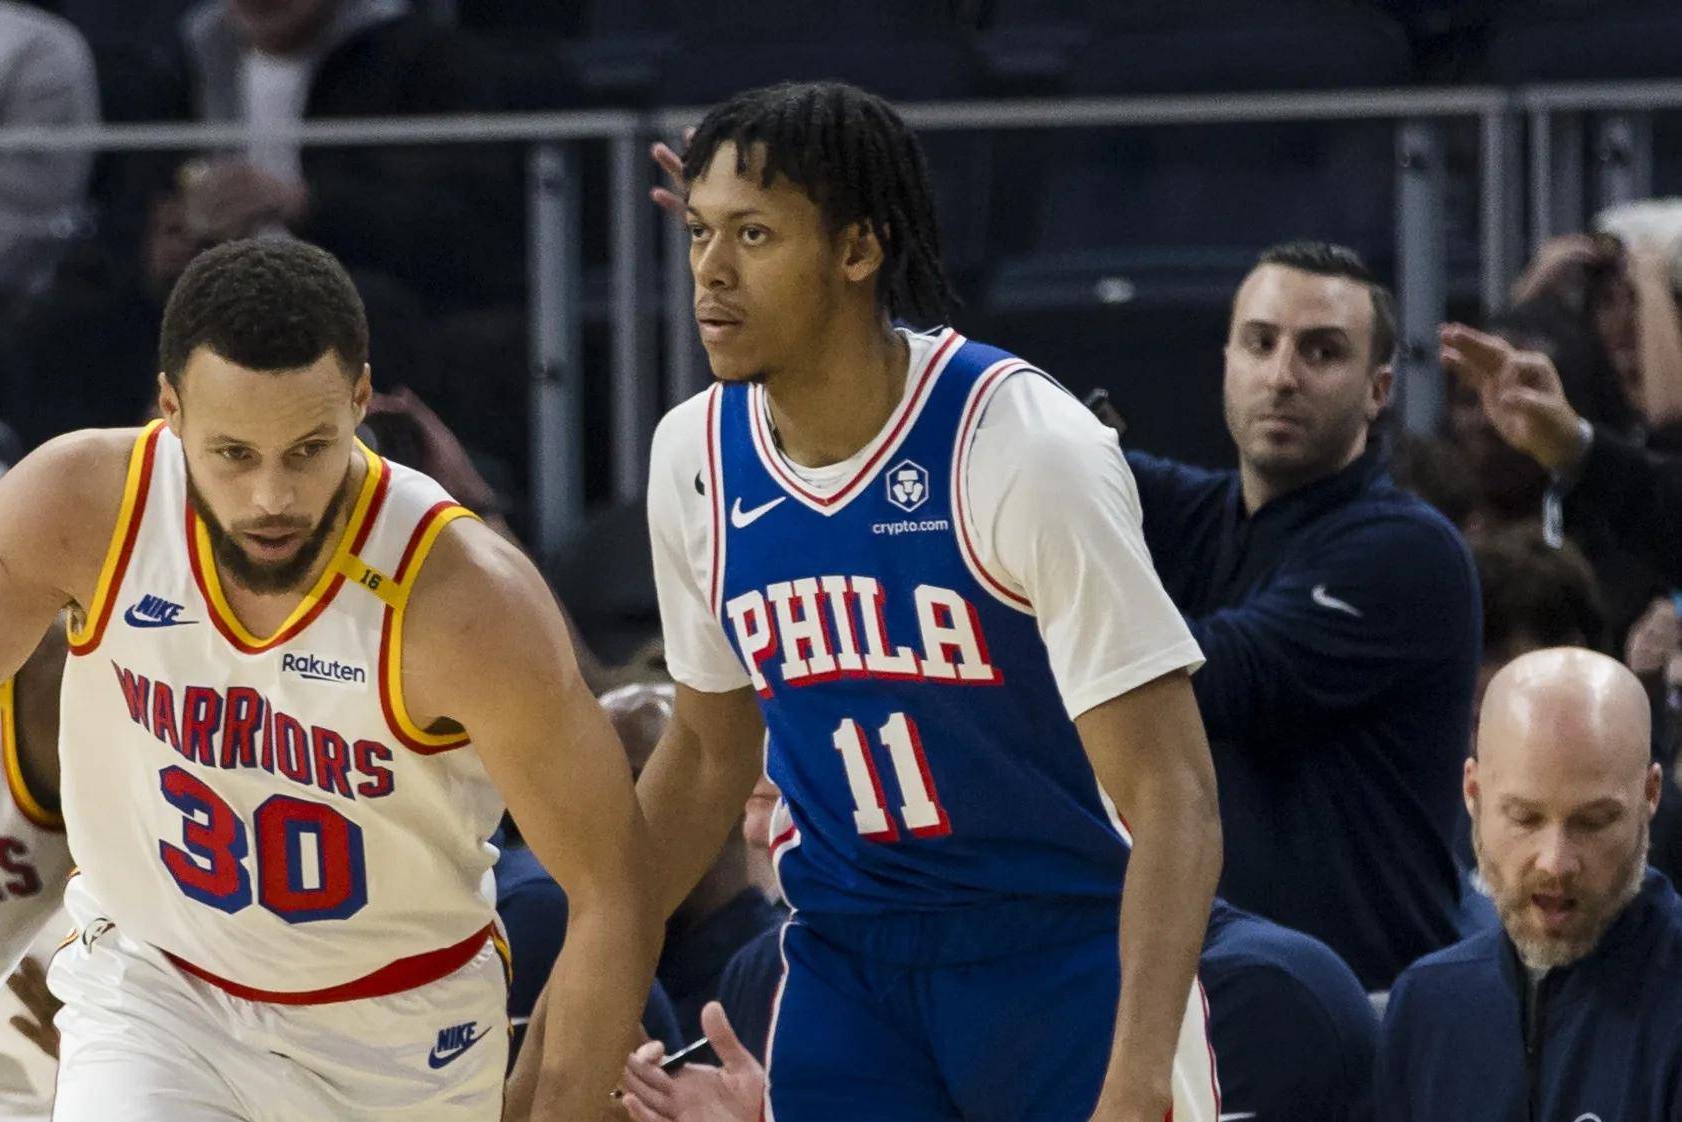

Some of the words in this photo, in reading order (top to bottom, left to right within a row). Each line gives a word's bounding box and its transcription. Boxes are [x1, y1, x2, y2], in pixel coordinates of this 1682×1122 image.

[872, 519, 950, 536] crypto.com
[360, 568, 382, 590] 16
[135, 594, 185, 623] NIKE
[726, 575, 1004, 698] PHILA
[282, 653, 366, 683] Rakuten
[112, 660, 395, 800] WARRIORS
[833, 712, 952, 843] 11
[159, 764, 369, 924] 30
[437, 1021, 477, 1053] NIKE
